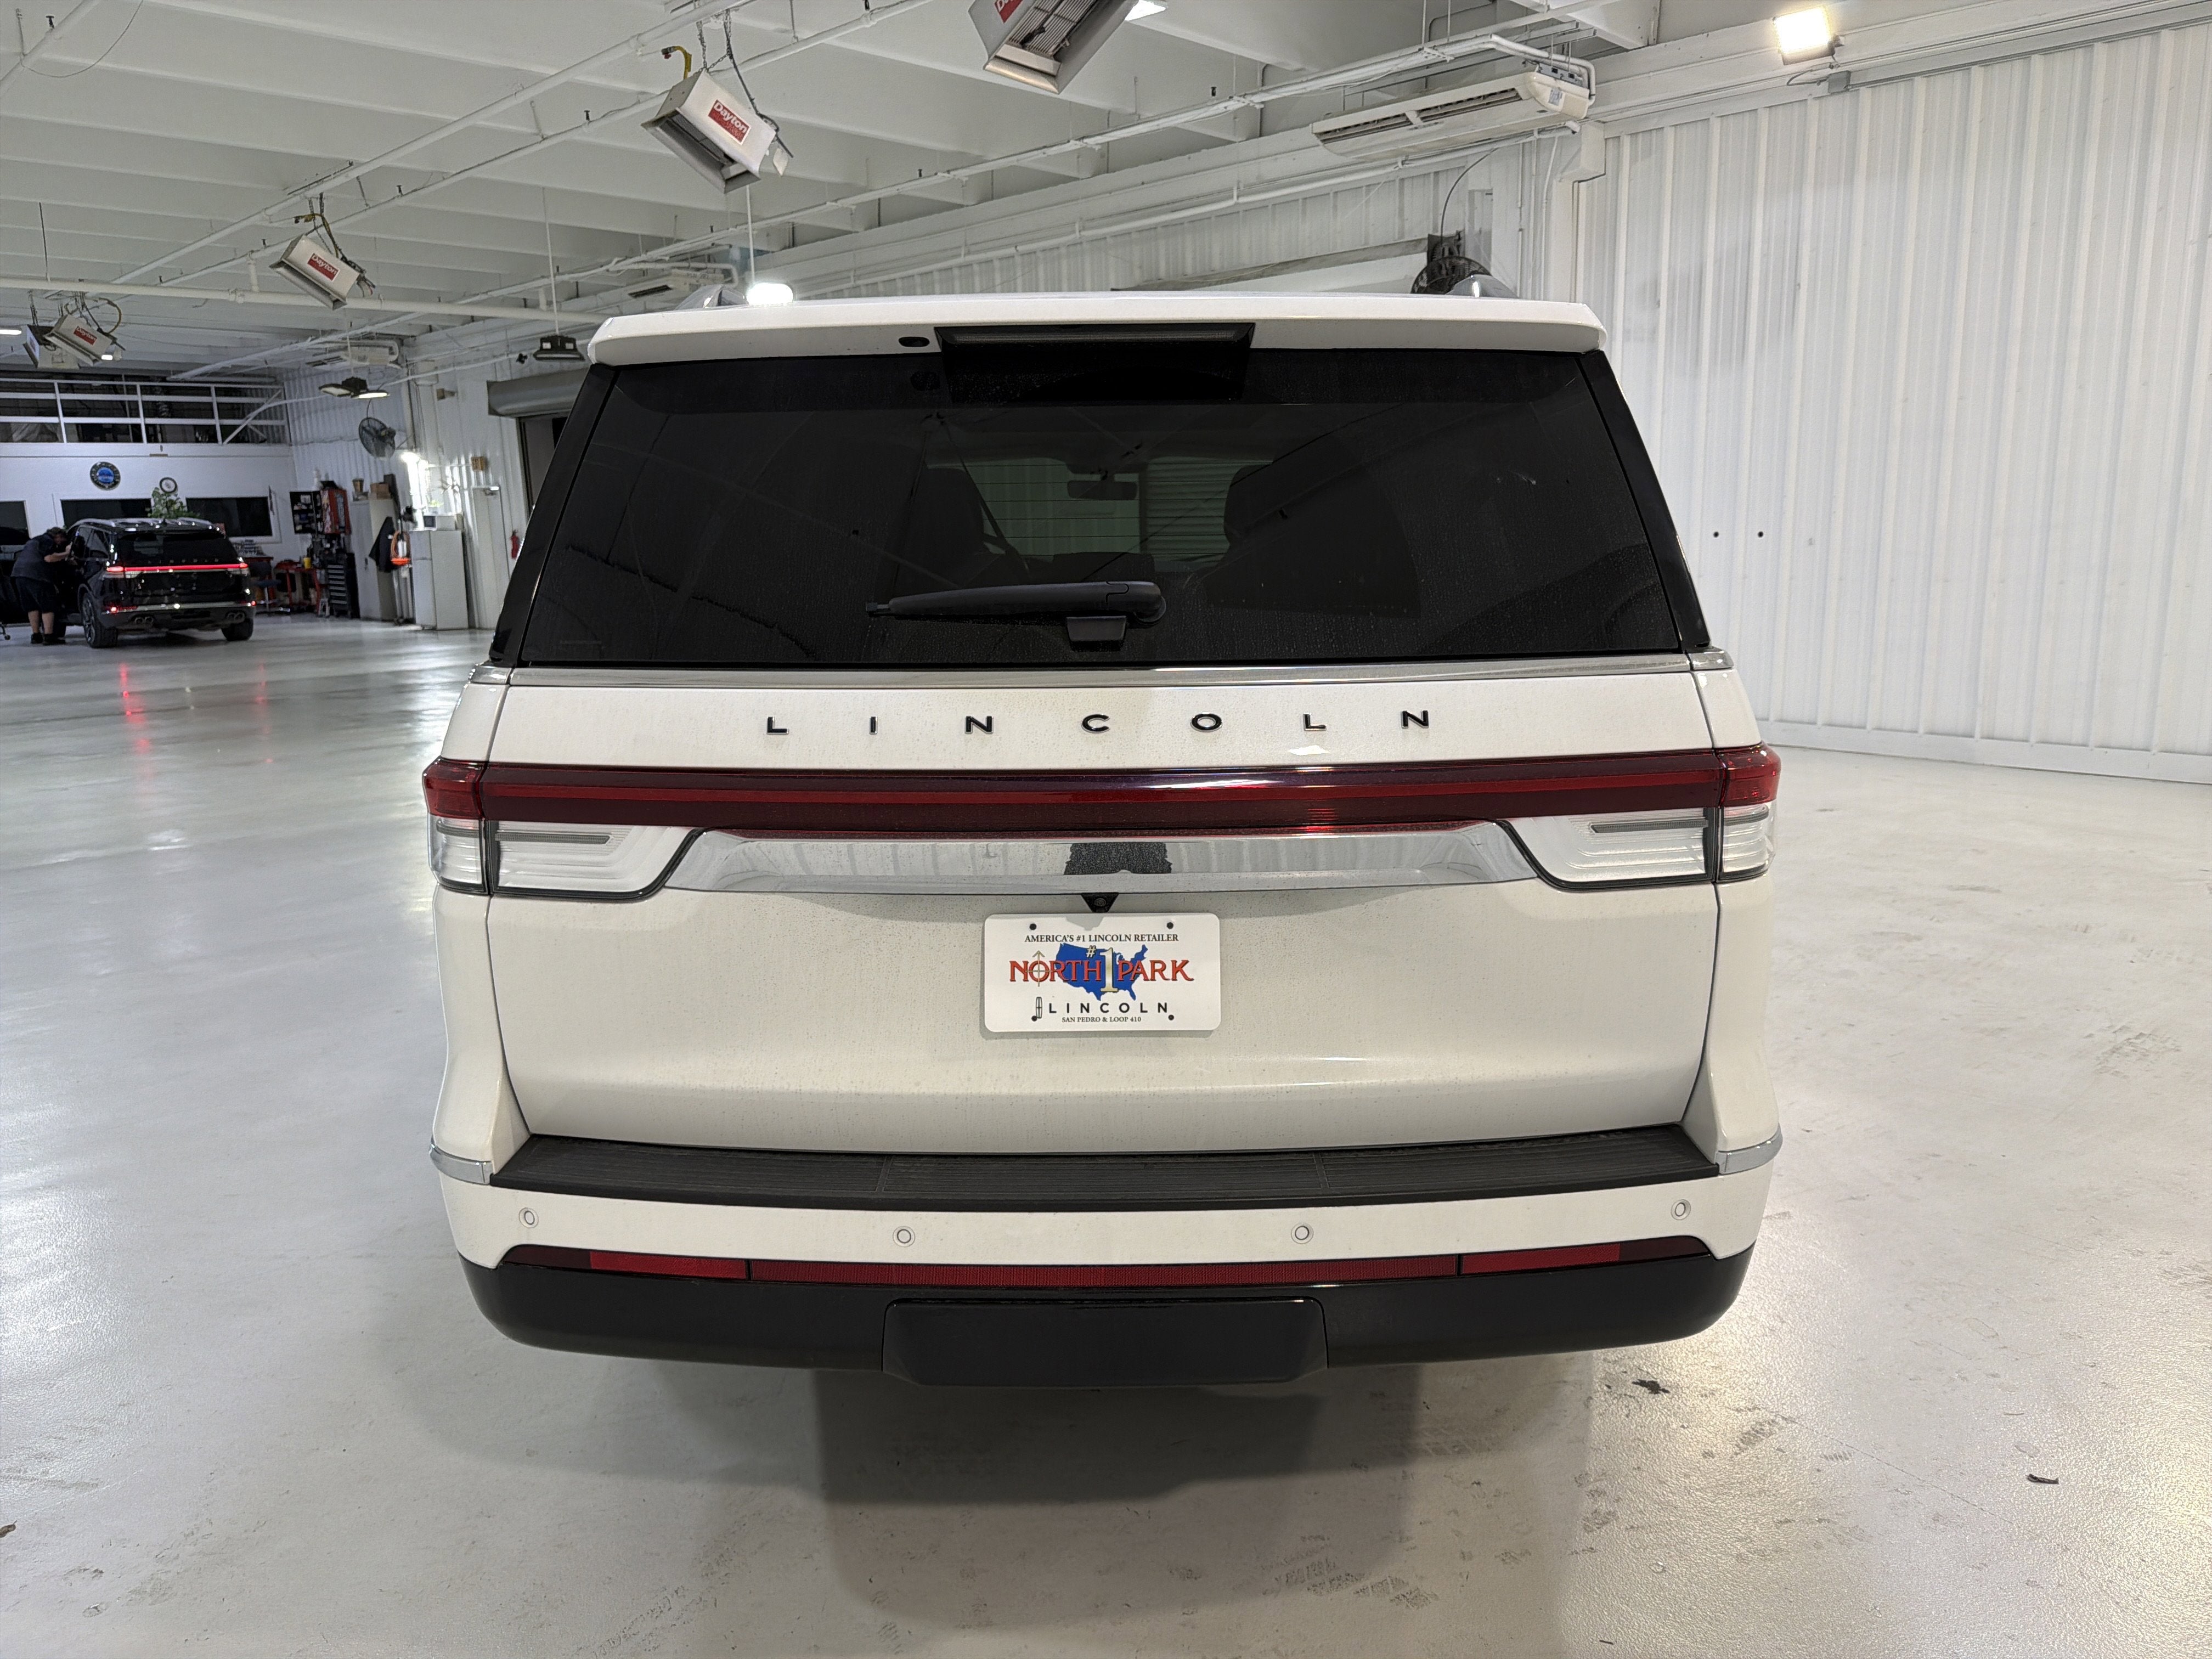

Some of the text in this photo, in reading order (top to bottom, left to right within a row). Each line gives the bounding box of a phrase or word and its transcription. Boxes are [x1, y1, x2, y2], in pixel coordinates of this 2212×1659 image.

[714, 102, 747, 133] Dayton
[312, 255, 337, 275] Dayton
[766, 709, 1430, 735] LINCOLN
[1088, 934, 1131, 942] LINCOLN
[1009, 960, 1194, 982] NORTH PARK
[1048, 1002, 1167, 1014] LINCOLN
